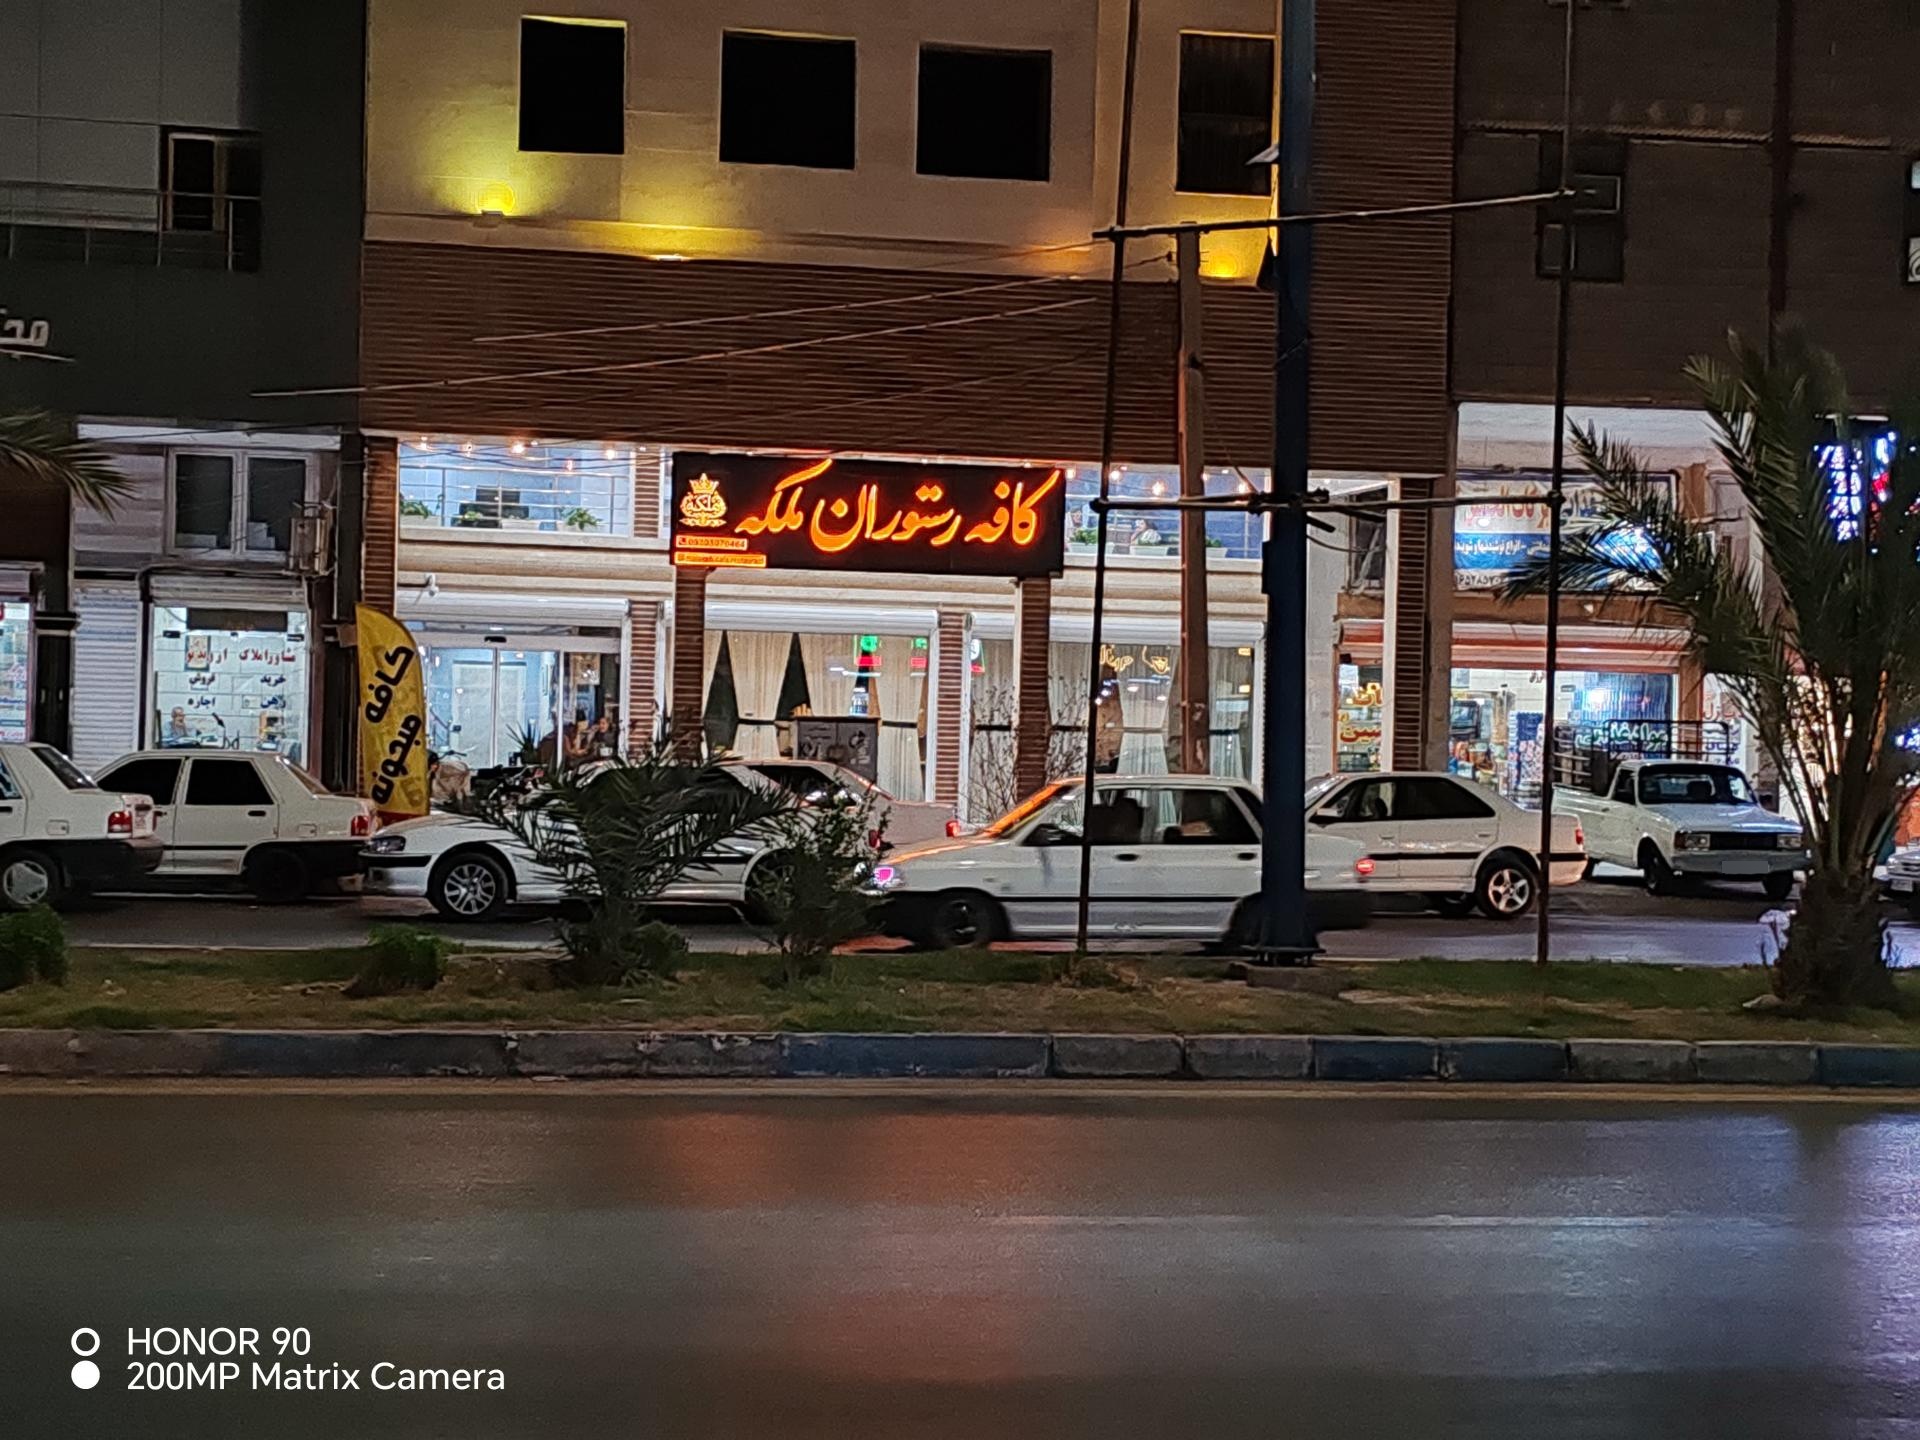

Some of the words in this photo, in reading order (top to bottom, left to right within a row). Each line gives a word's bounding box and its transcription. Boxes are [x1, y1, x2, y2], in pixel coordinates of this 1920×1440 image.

[734, 458, 832, 534] ملکه
[810, 483, 962, 552] رستوران
[964, 468, 1061, 546] کافه
[187, 696, 216, 710] اجاره
[189, 673, 216, 686] فروش
[260, 674, 286, 687] خرید
[260, 695, 286, 709] رهن
[365, 645, 415, 724] کافه
[371, 714, 422, 805] صبحونه
